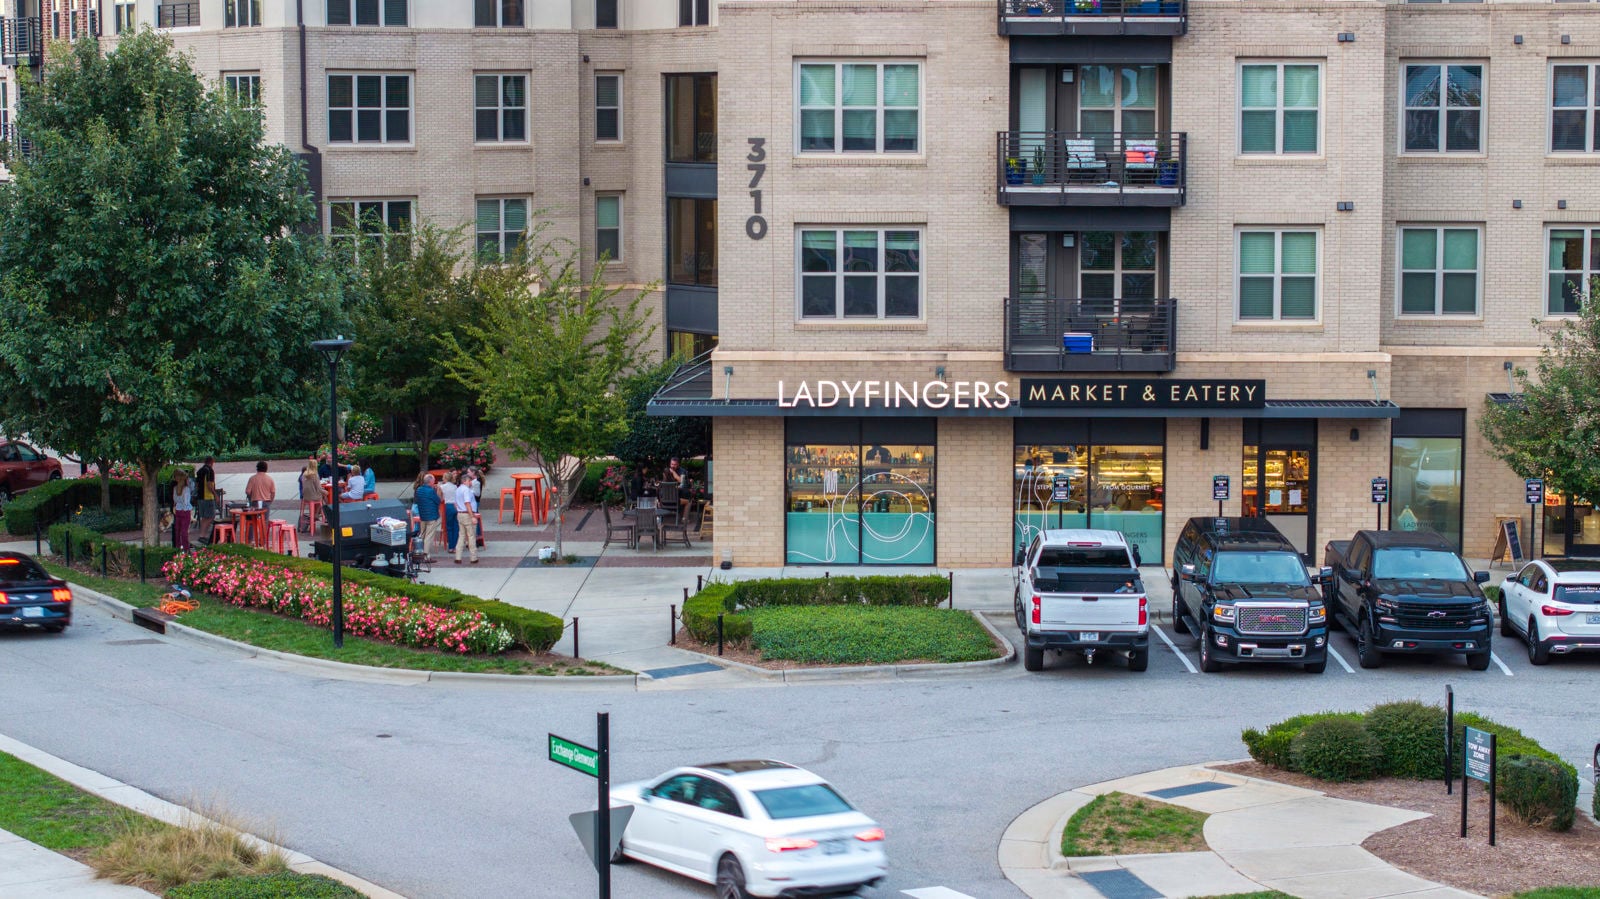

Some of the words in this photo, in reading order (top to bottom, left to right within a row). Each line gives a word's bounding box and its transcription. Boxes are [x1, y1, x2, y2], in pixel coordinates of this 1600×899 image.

[746, 138, 768, 240] 3710
[778, 380, 1010, 408] LADYFINGERS
[1028, 384, 1128, 401] MARKET
[1142, 384, 1156, 401] &
[1170, 385, 1257, 401] EATERY
[552, 740, 574, 763] Exchange
[573, 747, 596, 768] Glenwood
[1468, 742, 1478, 751] TOW
[1472, 751, 1485, 760] ZONE
